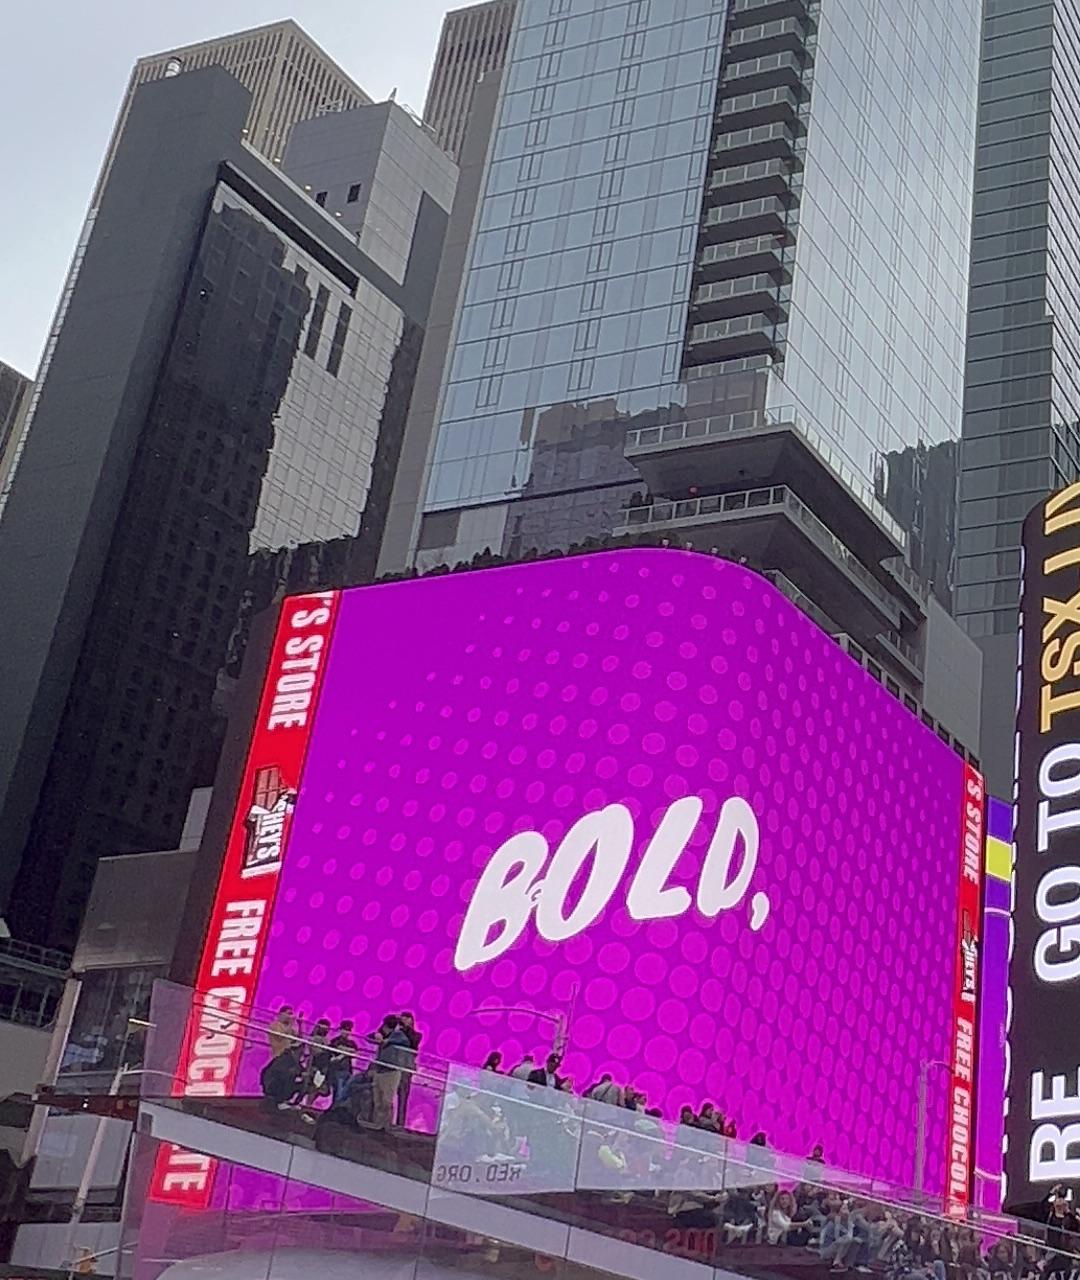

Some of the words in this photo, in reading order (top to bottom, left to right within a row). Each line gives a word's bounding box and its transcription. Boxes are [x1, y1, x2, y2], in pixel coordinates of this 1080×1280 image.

[267, 635, 324, 731] STORE
[454, 796, 769, 970] BOLD,
[211, 899, 266, 977] FREE
[954, 1017, 972, 1082] FREE
